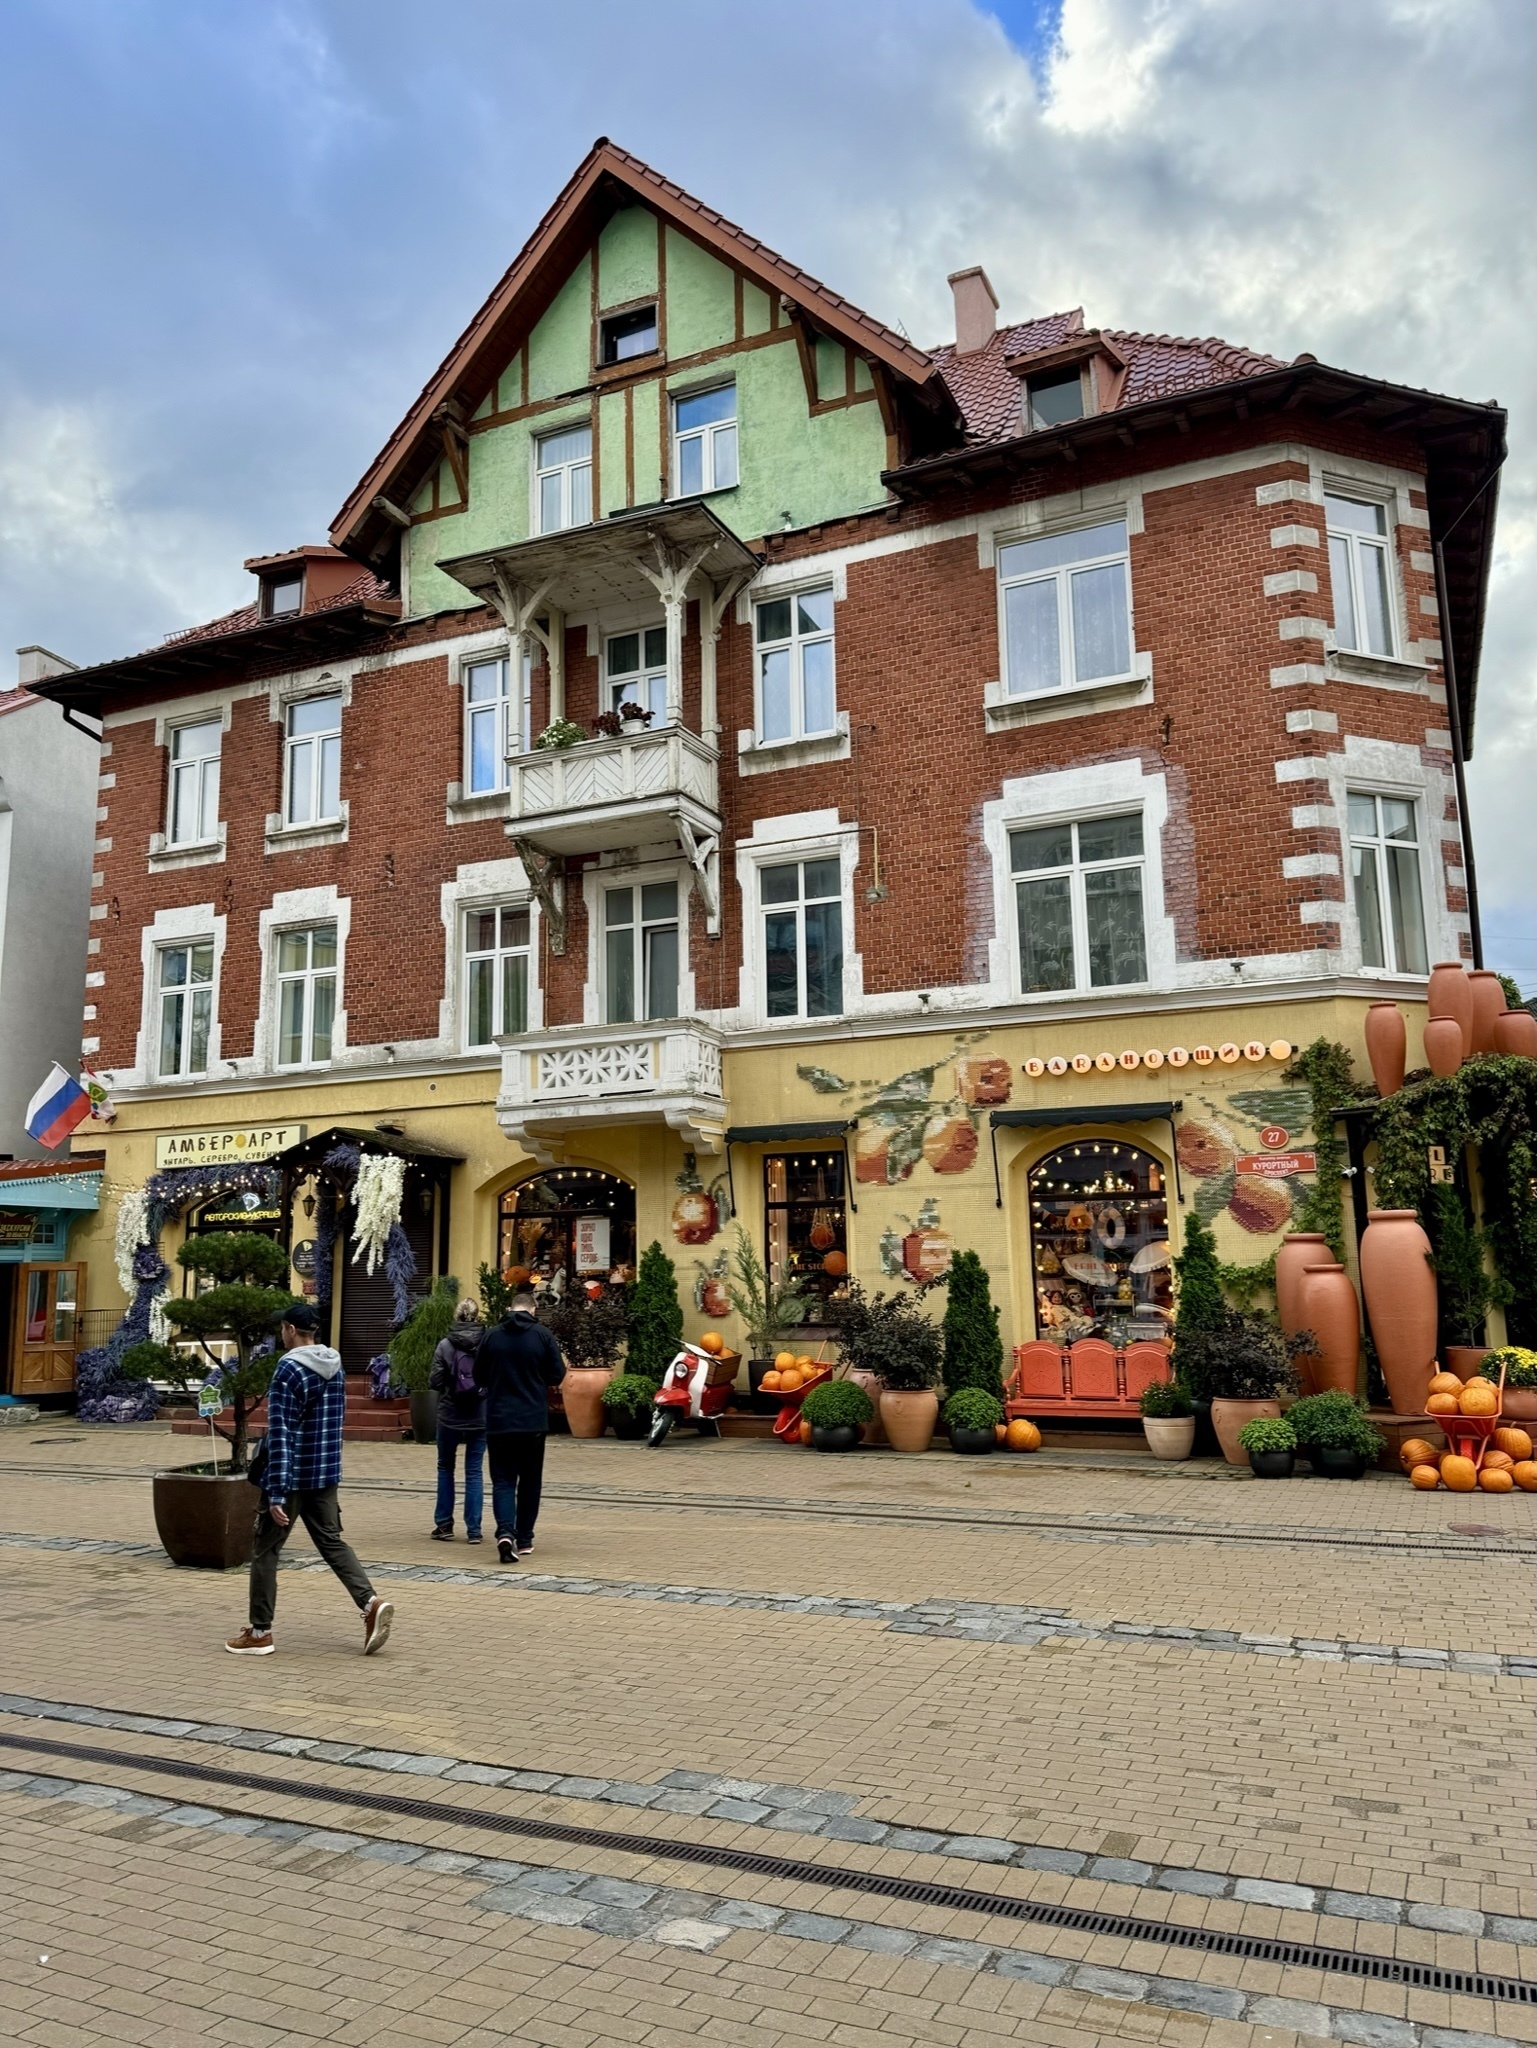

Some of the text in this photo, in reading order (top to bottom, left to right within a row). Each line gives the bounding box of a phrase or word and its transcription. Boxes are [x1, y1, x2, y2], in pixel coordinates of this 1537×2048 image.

[167, 1130, 287, 1154] АМБЕР АРТ
[1267, 1132, 1280, 1142] 27
[1252, 1159, 1299, 1170] КУРОРТНЫЙ
